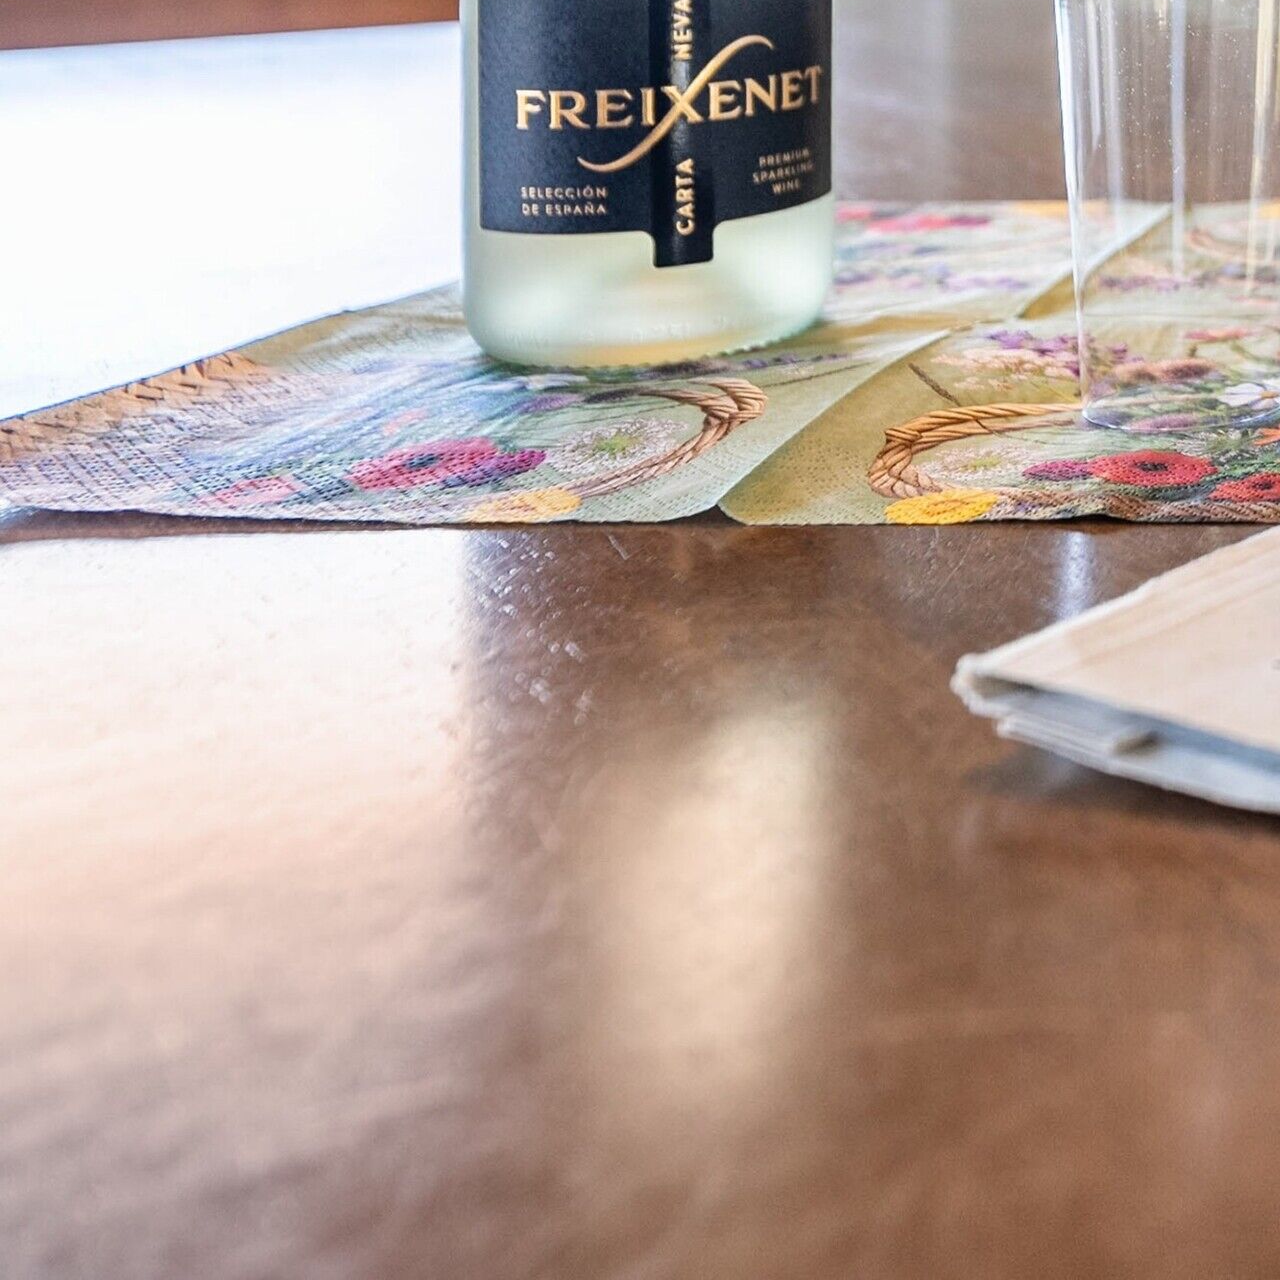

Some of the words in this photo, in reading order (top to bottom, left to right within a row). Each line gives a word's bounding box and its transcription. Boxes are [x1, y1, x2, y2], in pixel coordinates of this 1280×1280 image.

[515, 34, 823, 173] FREIXENET
[759, 148, 810, 167] PREMIUM
[752, 161, 815, 183] SPARKLING
[520, 184, 607, 199] SELECCIÓN
[772, 179, 800, 194] WINE
[675, 157, 696, 237] CARTA
[521, 203, 539, 216] DE
[545, 201, 607, 216] ESPAÑA
